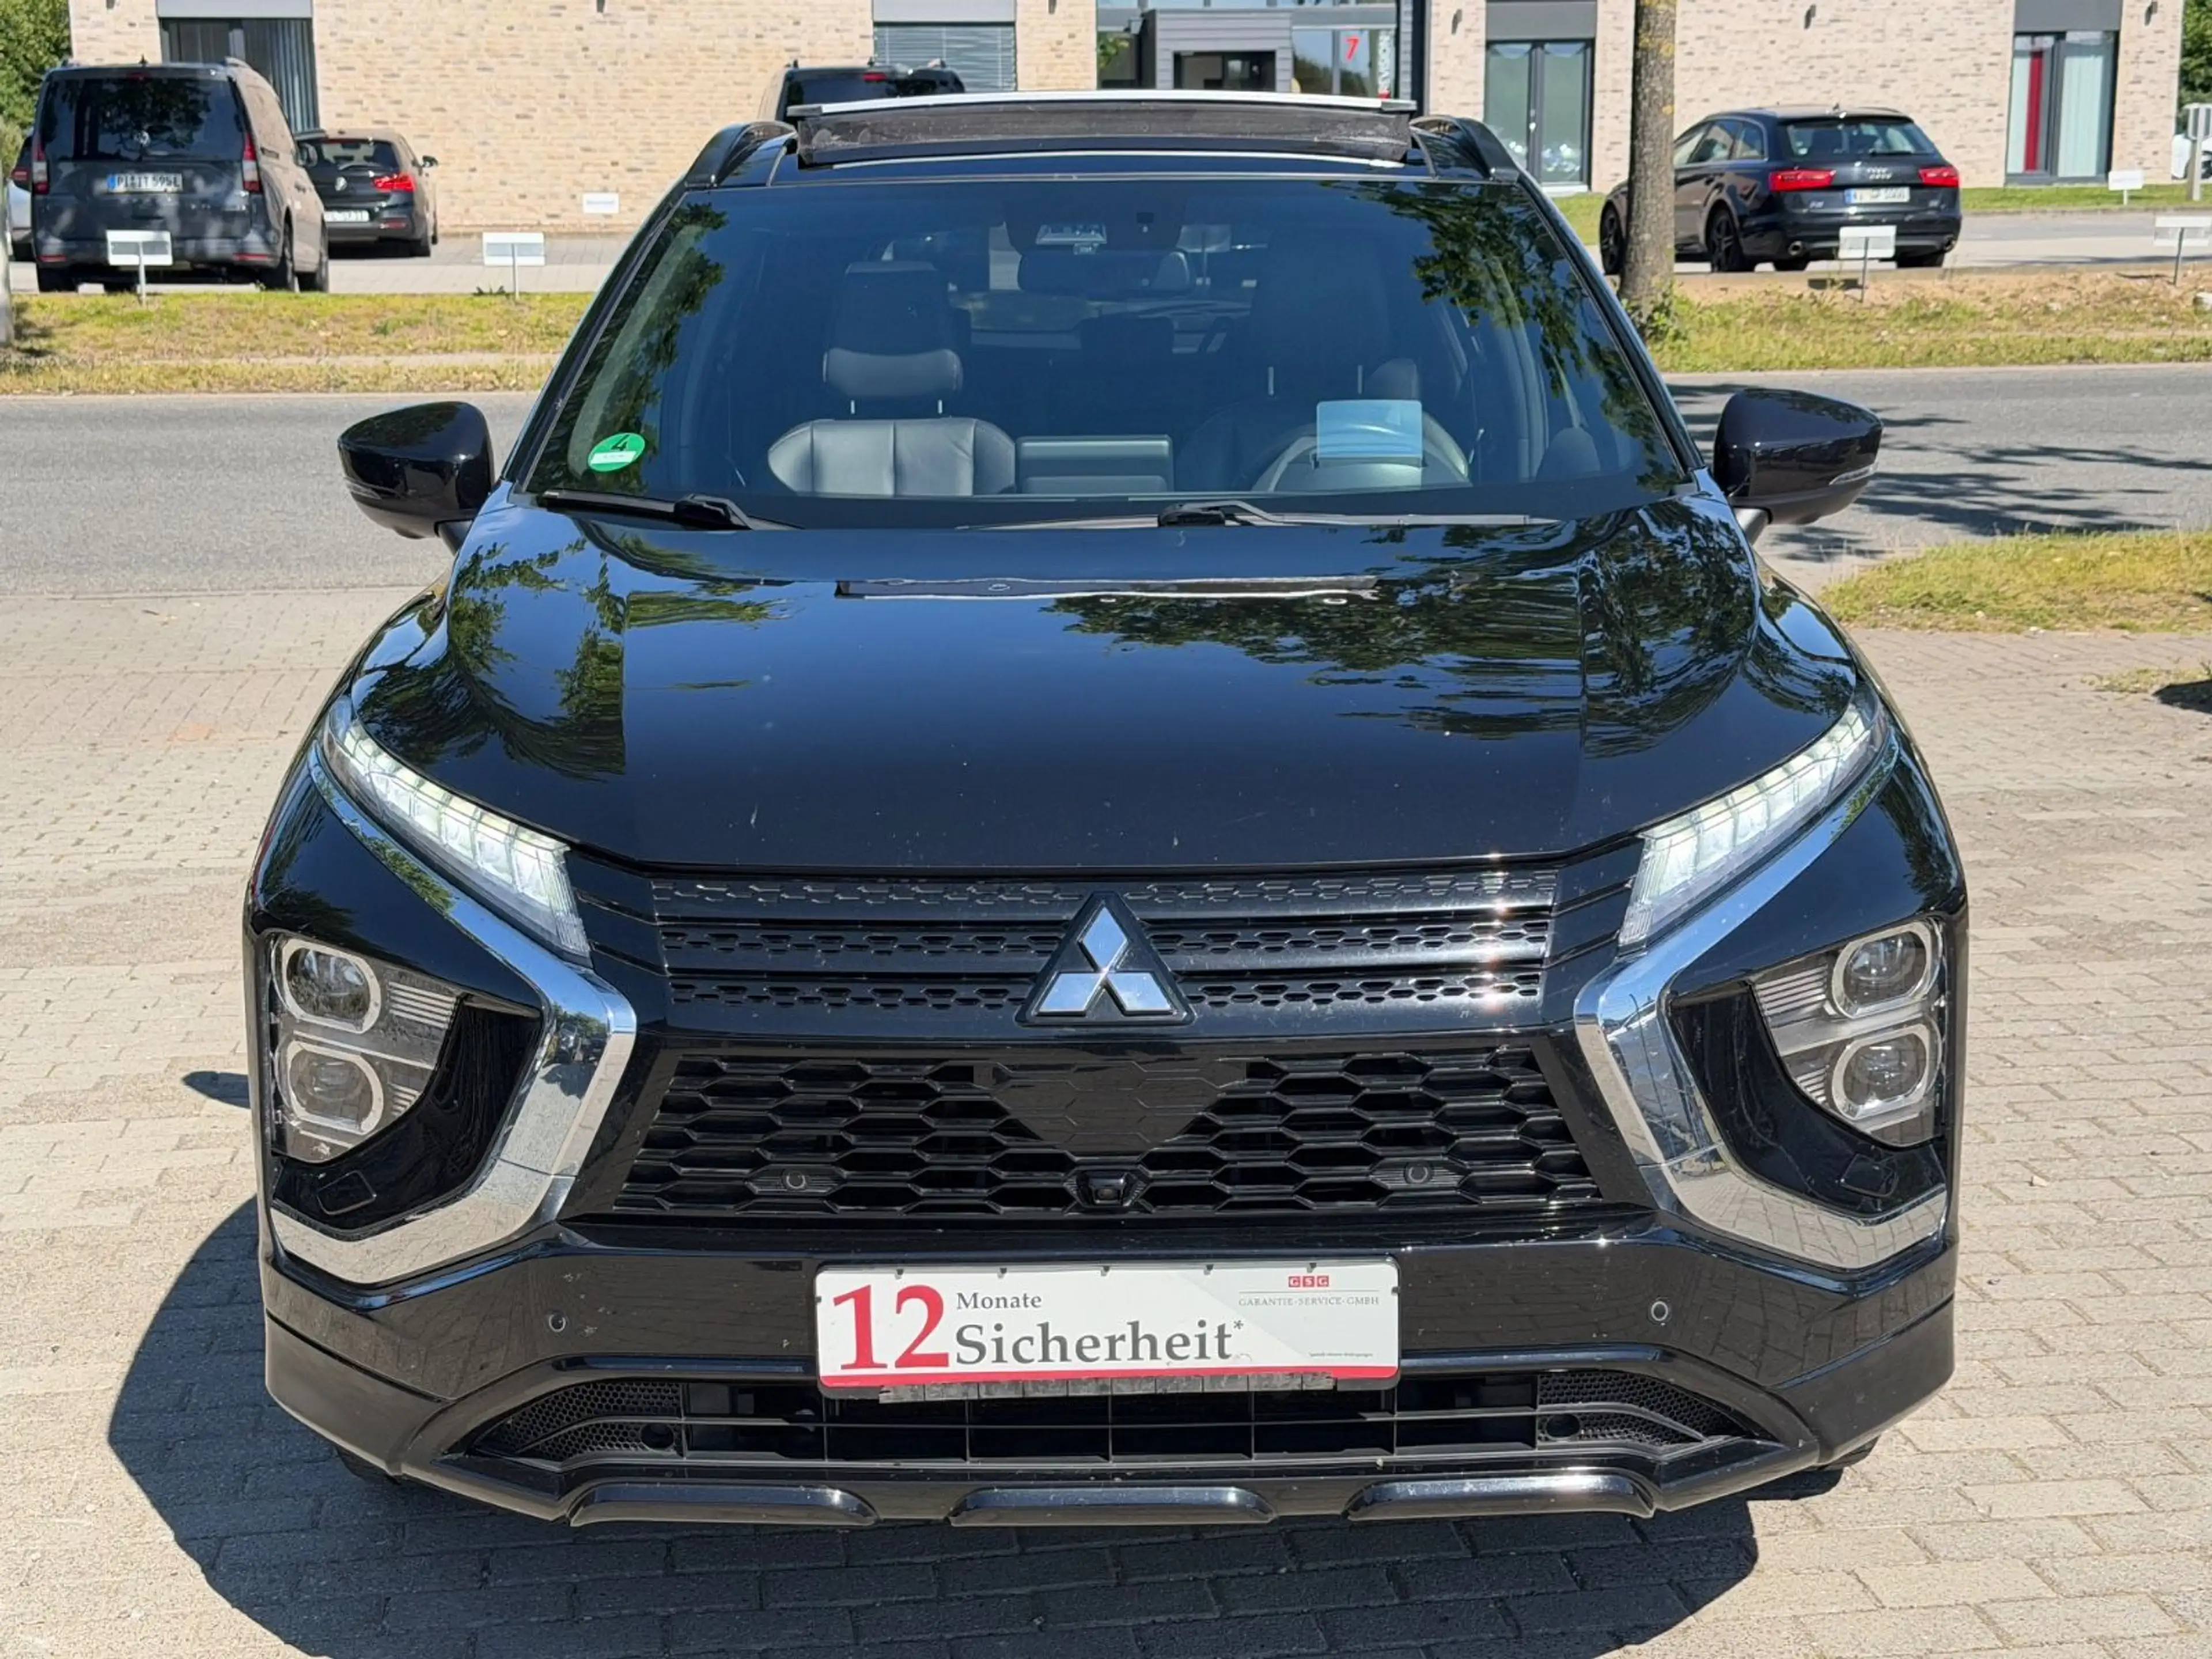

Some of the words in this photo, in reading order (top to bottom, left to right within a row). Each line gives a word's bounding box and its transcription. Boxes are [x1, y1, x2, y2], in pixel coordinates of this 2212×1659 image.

[1346, 36, 1359, 60] 7
[610, 434, 630, 451] 4
[956, 1292, 1043, 1310] Monate
[832, 1284, 949, 1370] 12
